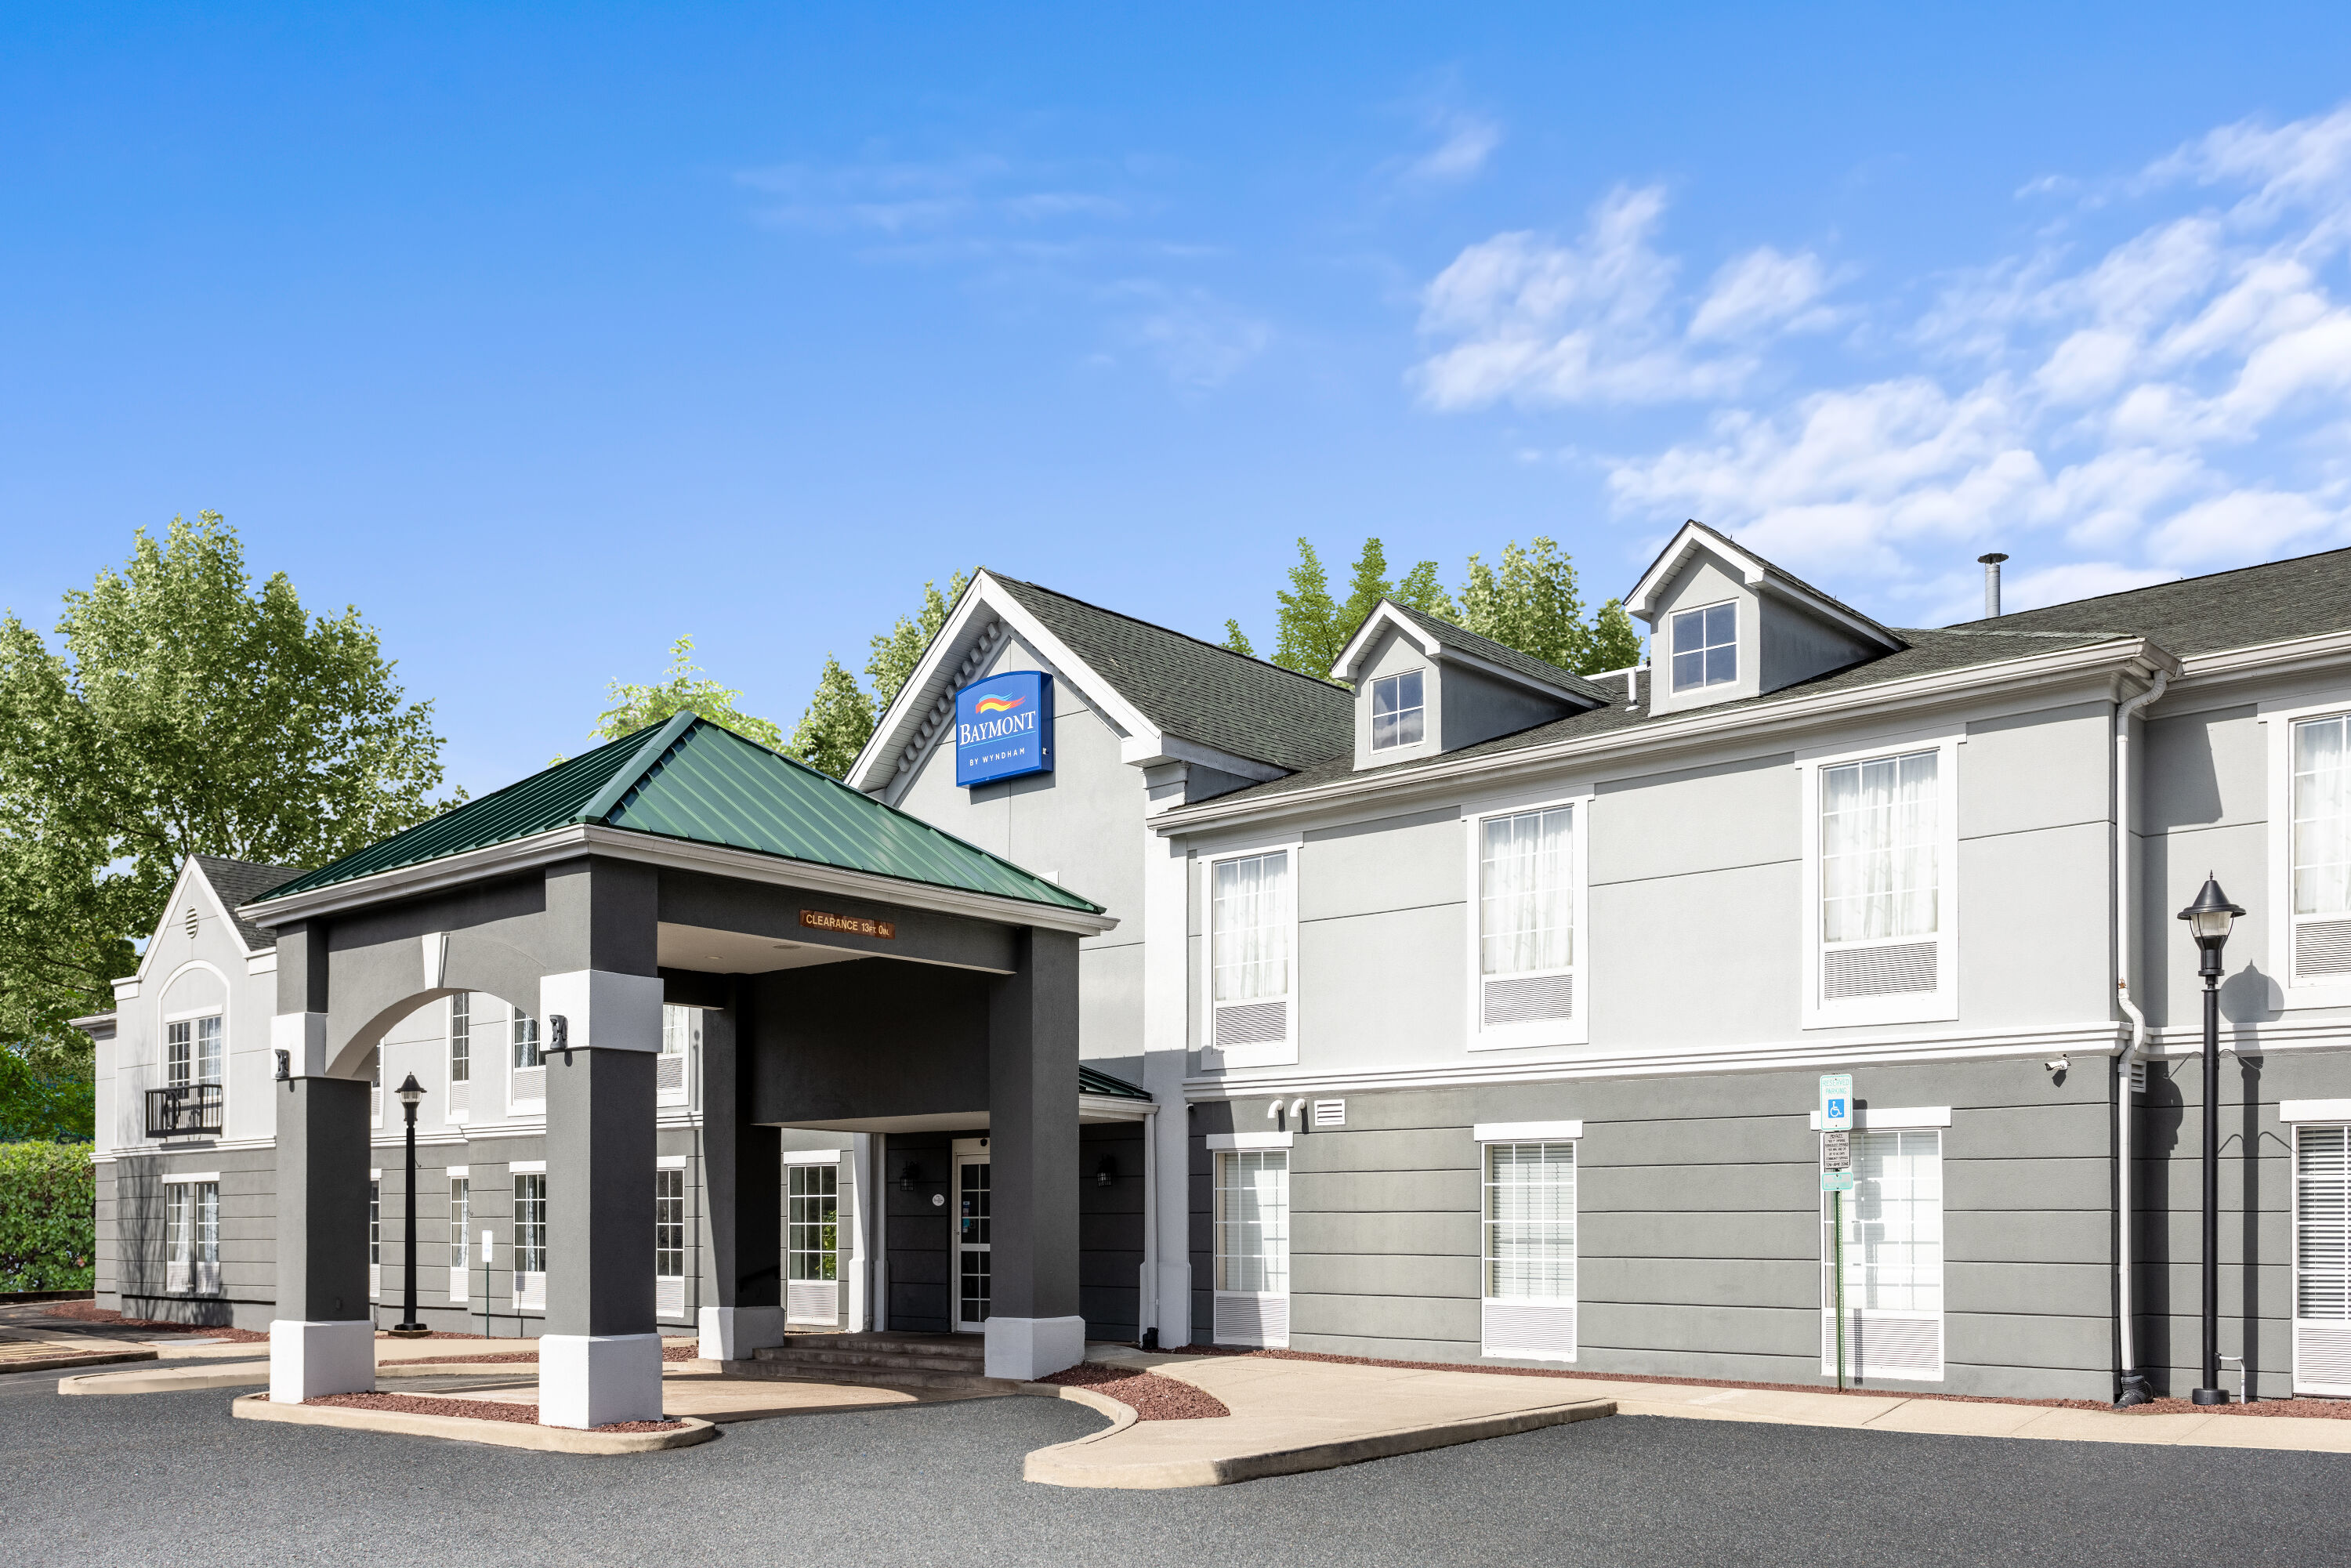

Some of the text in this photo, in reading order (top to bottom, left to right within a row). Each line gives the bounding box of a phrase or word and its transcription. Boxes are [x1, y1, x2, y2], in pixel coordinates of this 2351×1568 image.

[960, 711, 1035, 745] BAYMONT
[969, 748, 1025, 766] BY WYNDHAM
[806, 914, 858, 931] CLEARANCE
[1823, 1078, 1849, 1087] RESERVED
